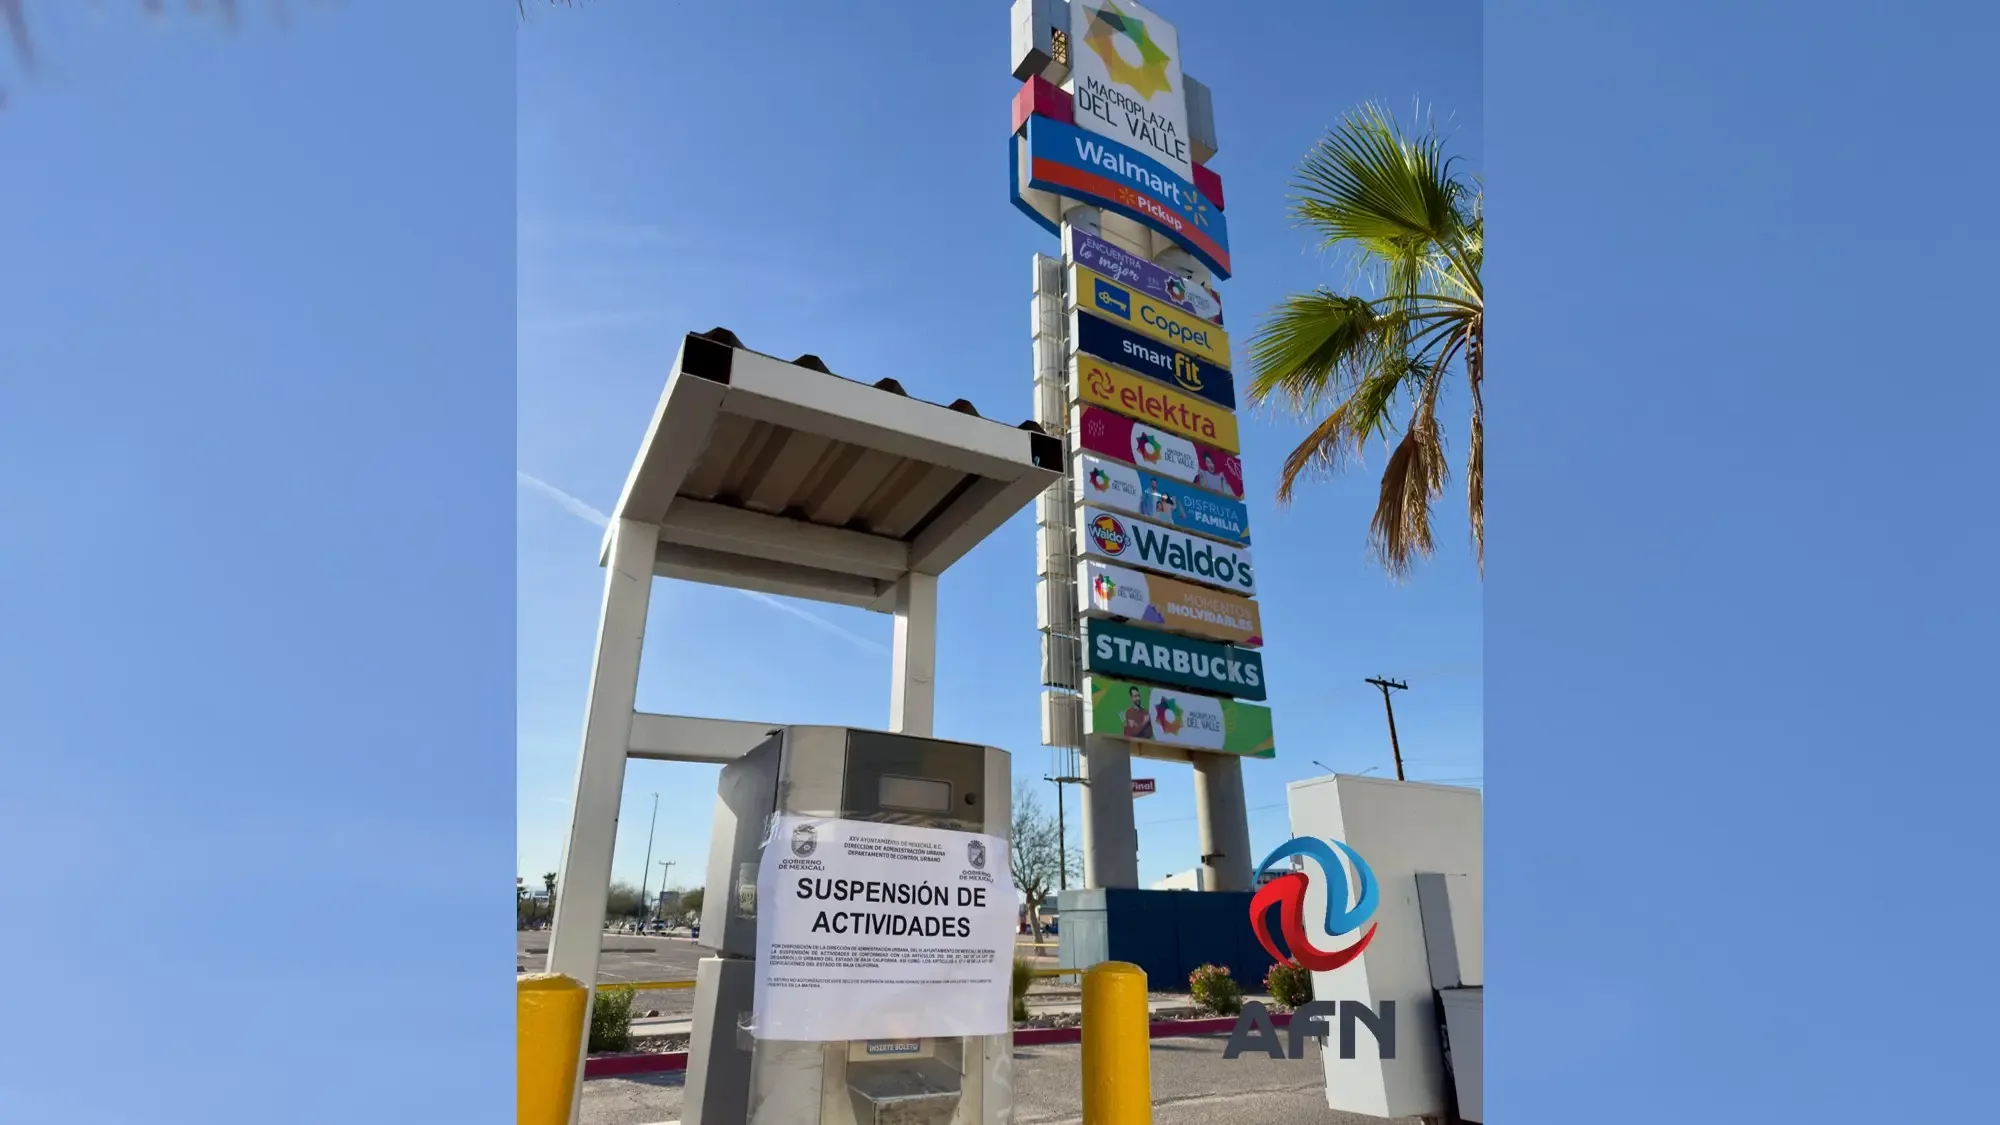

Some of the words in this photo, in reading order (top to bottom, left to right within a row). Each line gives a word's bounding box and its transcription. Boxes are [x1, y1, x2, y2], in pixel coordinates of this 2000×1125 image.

[1087, 75, 1176, 136] MACROPLAZA
[1078, 86, 1118, 127] DEL
[1125, 113, 1188, 164] VALLE
[1075, 136, 1181, 205] Walmart
[1137, 195, 1182, 231] Pickup
[1079, 242, 1093, 259] lo
[1098, 257, 1140, 281] mejor
[1086, 237, 1142, 269] ENCUENTRA
[1140, 304, 1211, 350] Coppel
[1123, 338, 1173, 370] smart
[1174, 352, 1202, 386] fit
[1119, 385, 1216, 440] elektra
[1164, 452, 1176, 464] DEL
[1177, 456, 1195, 469] VALLE
[1111, 483, 1121, 492] DEL
[1183, 495, 1239, 519] DISFRUTA
[1087, 523, 1132, 547] Waldo's
[1195, 512, 1240, 533] FAMILIA
[1131, 525, 1254, 588] Waldo's
[1117, 589, 1128, 598] DEL
[1184, 593, 1252, 619] MOMENTOS
[1166, 601, 1254, 631] INOLVIDABLES
[1096, 633, 1259, 688] STARBUCKS
[1186, 717, 1199, 729] DEL
[1200, 719, 1221, 732] VALLE
[844, 842, 874, 850] DIRECCIÓN
[882, 845, 926, 855] ADMINISTRACIÓN
[860, 836, 900, 846] AYUNTAMIENTO
[782, 858, 822, 866] GOBIERNO
[847, 850, 890, 859] DEPARTAMENTO
[896, 854, 919, 862] CONTROL
[796, 877, 949, 907] SUSPENSIÓN
[957, 886, 987, 908] DE
[811, 911, 971, 937] ACTIVIDADES
[869, 1044, 894, 1052] INSERTE
